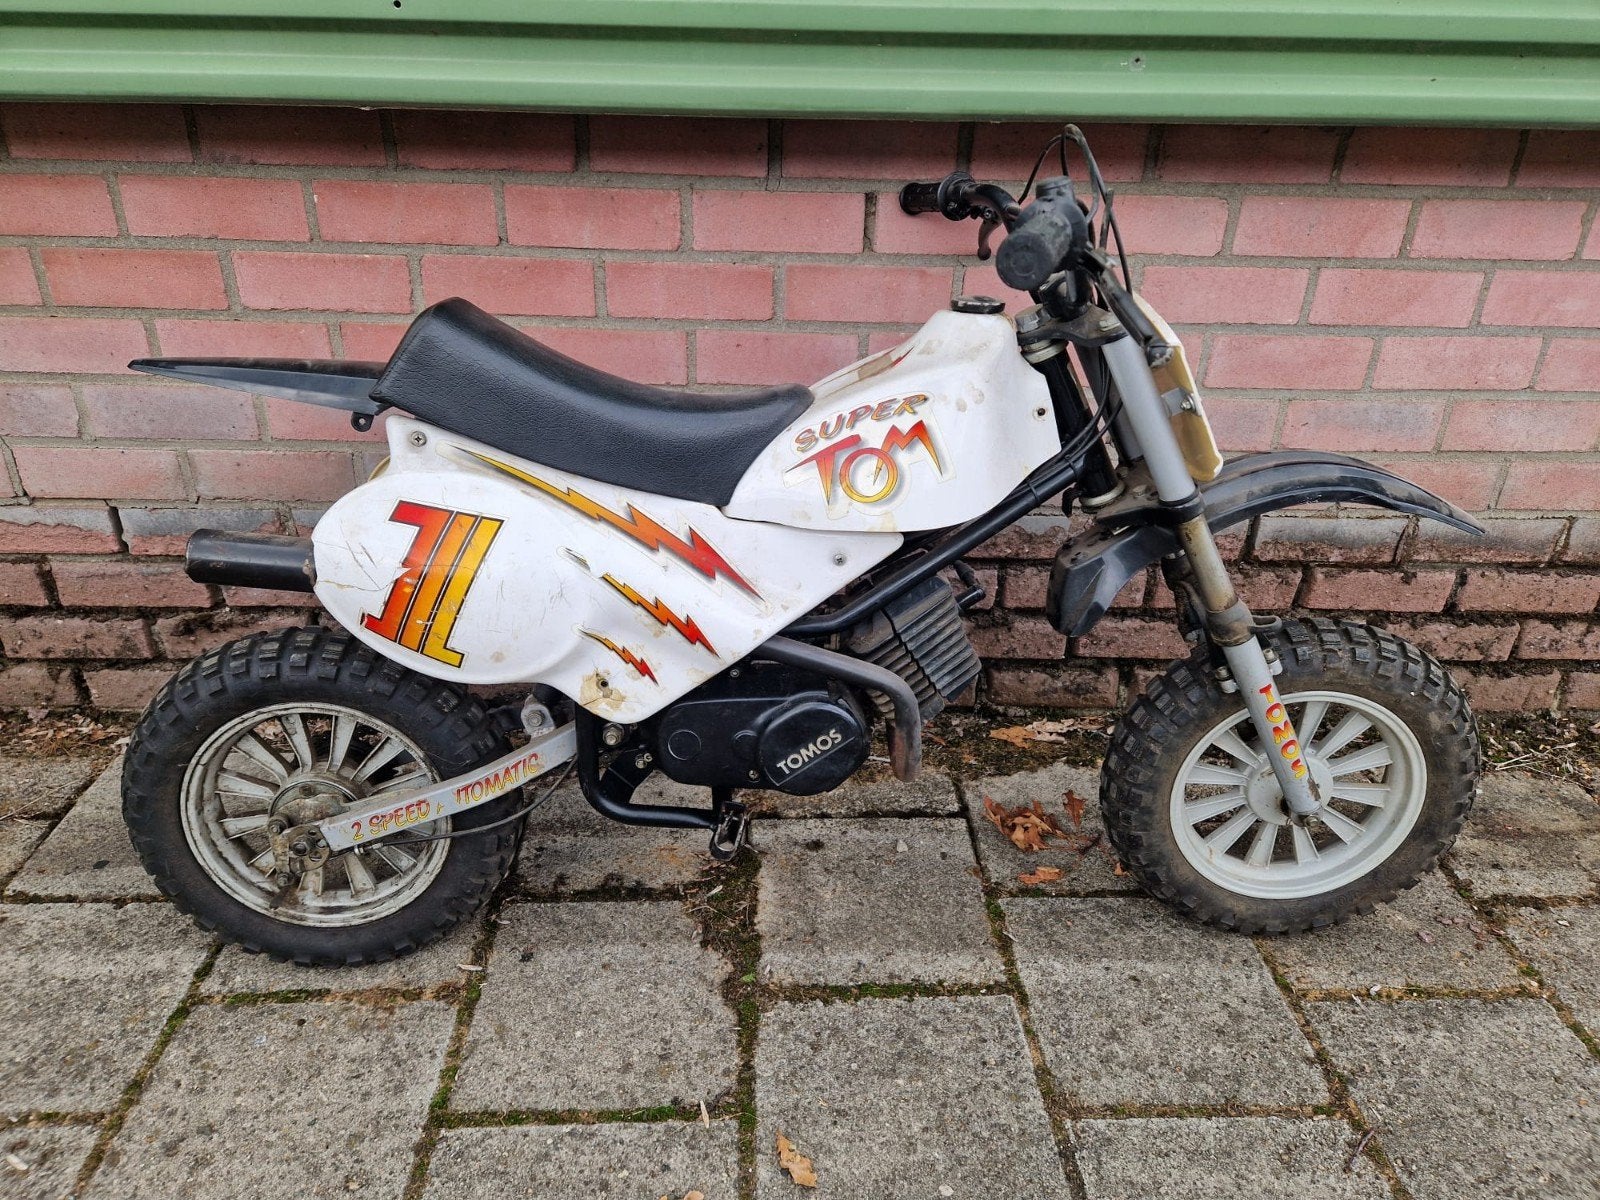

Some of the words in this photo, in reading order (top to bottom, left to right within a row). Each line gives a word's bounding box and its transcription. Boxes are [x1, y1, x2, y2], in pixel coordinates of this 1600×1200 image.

[794, 393, 929, 453] SUPER
[785, 419, 943, 504] TOM
[776, 728, 842, 775] TOMOS
[1259, 683, 1307, 779] TOMOS
[351, 820, 364, 840] 2
[368, 799, 431, 835] SPEED
